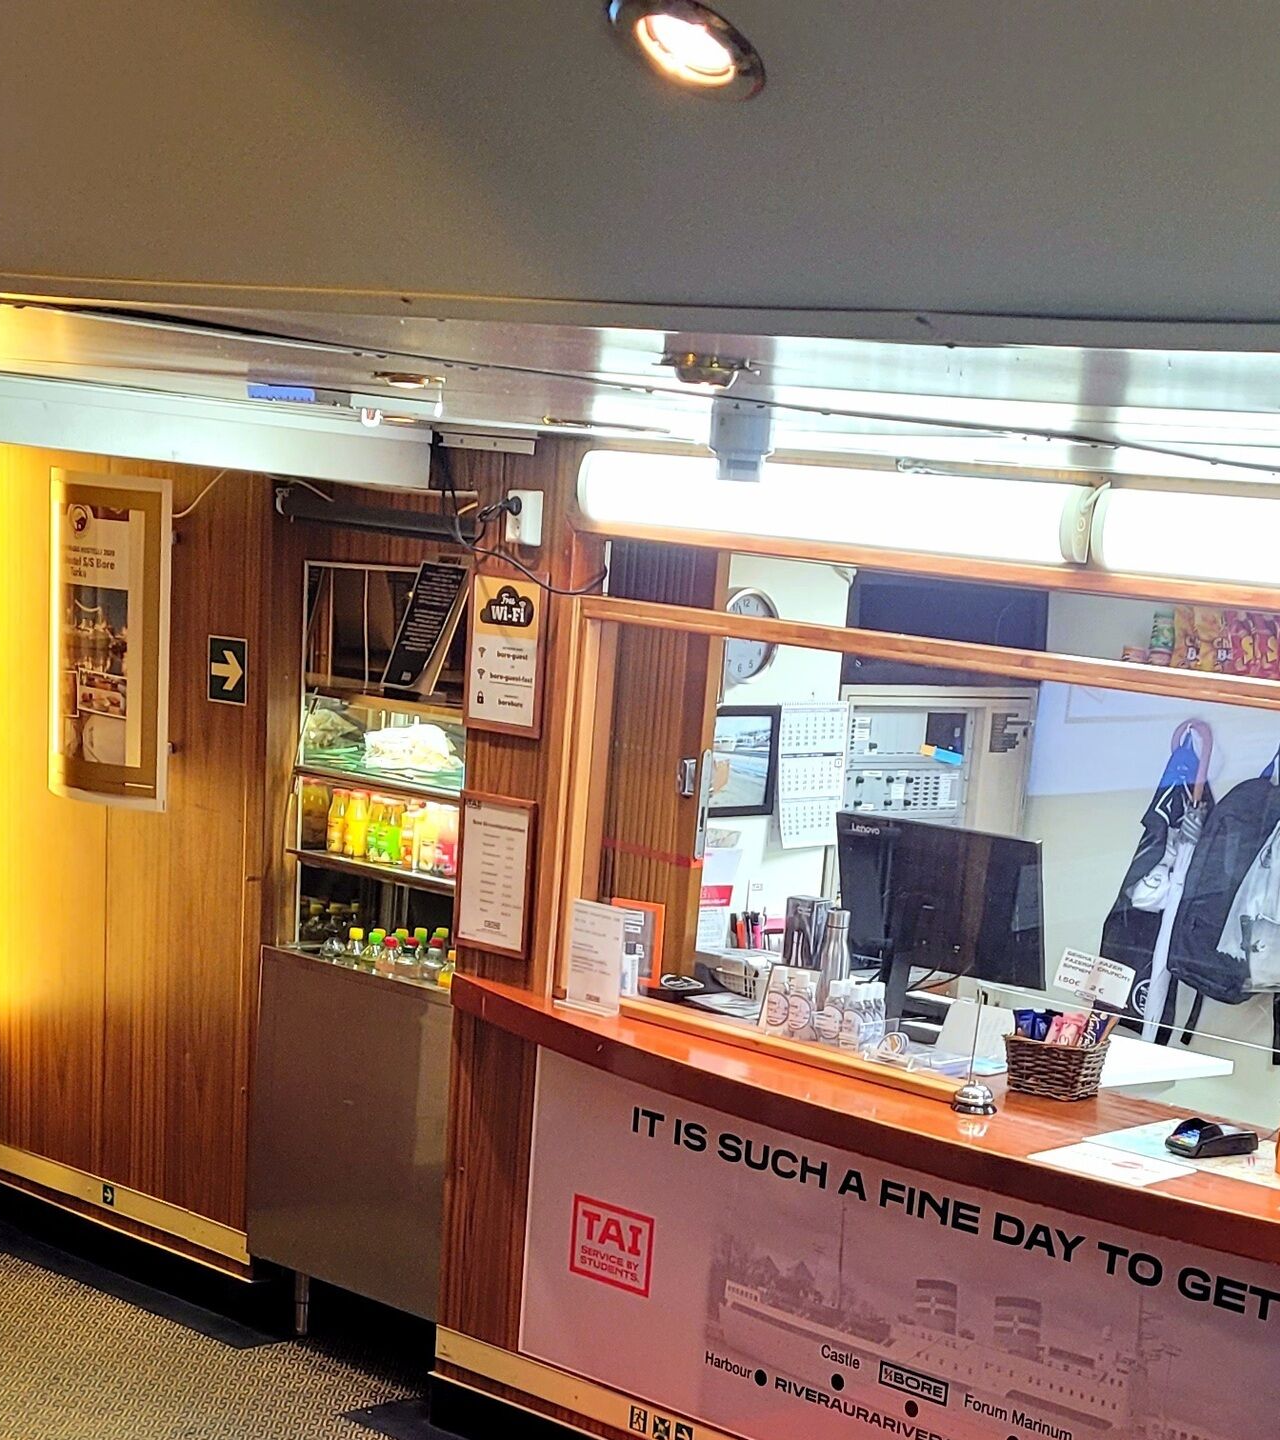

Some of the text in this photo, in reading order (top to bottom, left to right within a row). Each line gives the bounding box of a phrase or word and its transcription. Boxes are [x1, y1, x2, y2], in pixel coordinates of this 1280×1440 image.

[490, 605, 526, 623] Wi-Fi
[851, 822, 881, 835] Lenovo
[631, 1105, 665, 1139] IT
[673, 1118, 708, 1153] IS
[716, 1131, 828, 1191] SUCH
[837, 1168, 868, 1202] A
[878, 1177, 982, 1237] FINE
[991, 1210, 1087, 1264] DAY
[1096, 1239, 1164, 1288] TO
[581, 1208, 643, 1257] TAI
[580, 1244, 640, 1272] SERVICE BY
[704, 1349, 753, 1380] Harbour
[820, 1343, 861, 1371] Castle
[892, 1371, 945, 1399] BORE
[963, 1392, 1009, 1423] Forum
